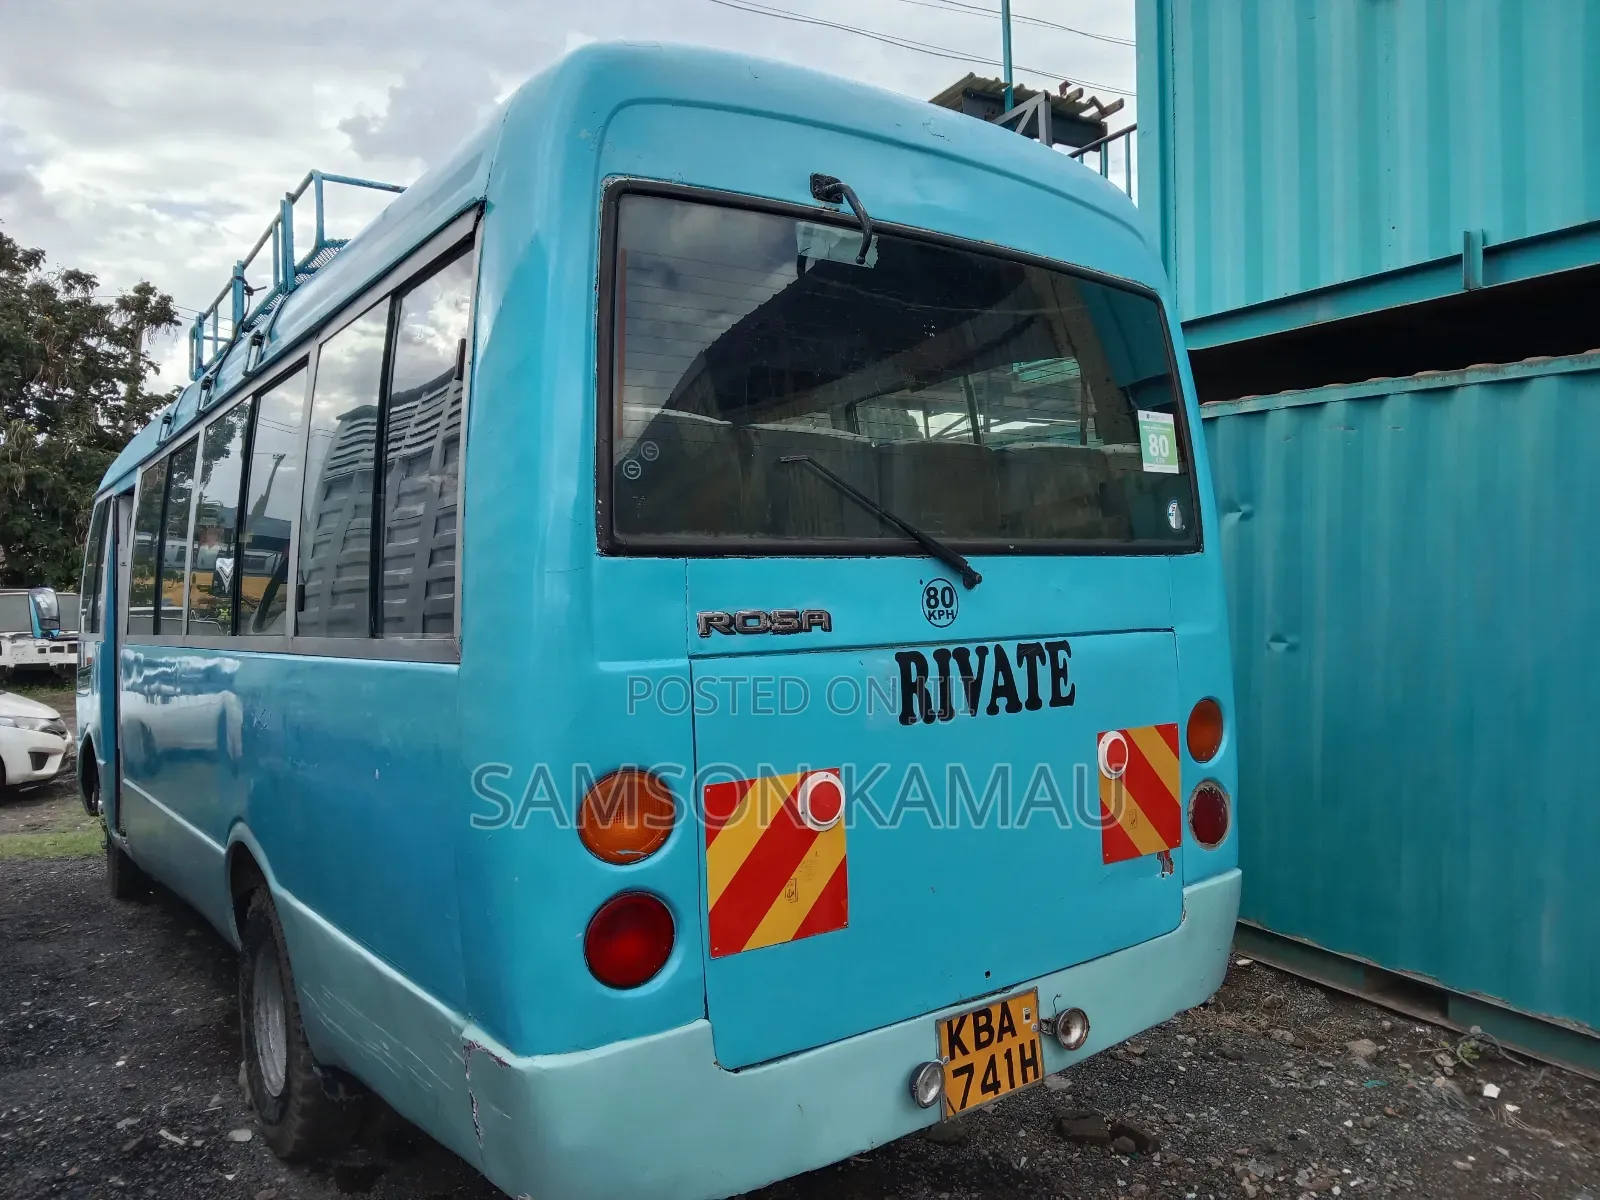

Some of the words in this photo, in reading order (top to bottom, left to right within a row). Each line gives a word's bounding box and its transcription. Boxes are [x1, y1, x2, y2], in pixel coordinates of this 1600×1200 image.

[1148, 433, 1169, 457] 80
[926, 586, 954, 609] 80
[696, 609, 832, 638] ROSA
[928, 609, 954, 620] KPH
[895, 640, 1075, 726] RIVATE
[946, 1001, 1018, 1061] KBA
[951, 1039, 1039, 1110] 741H
